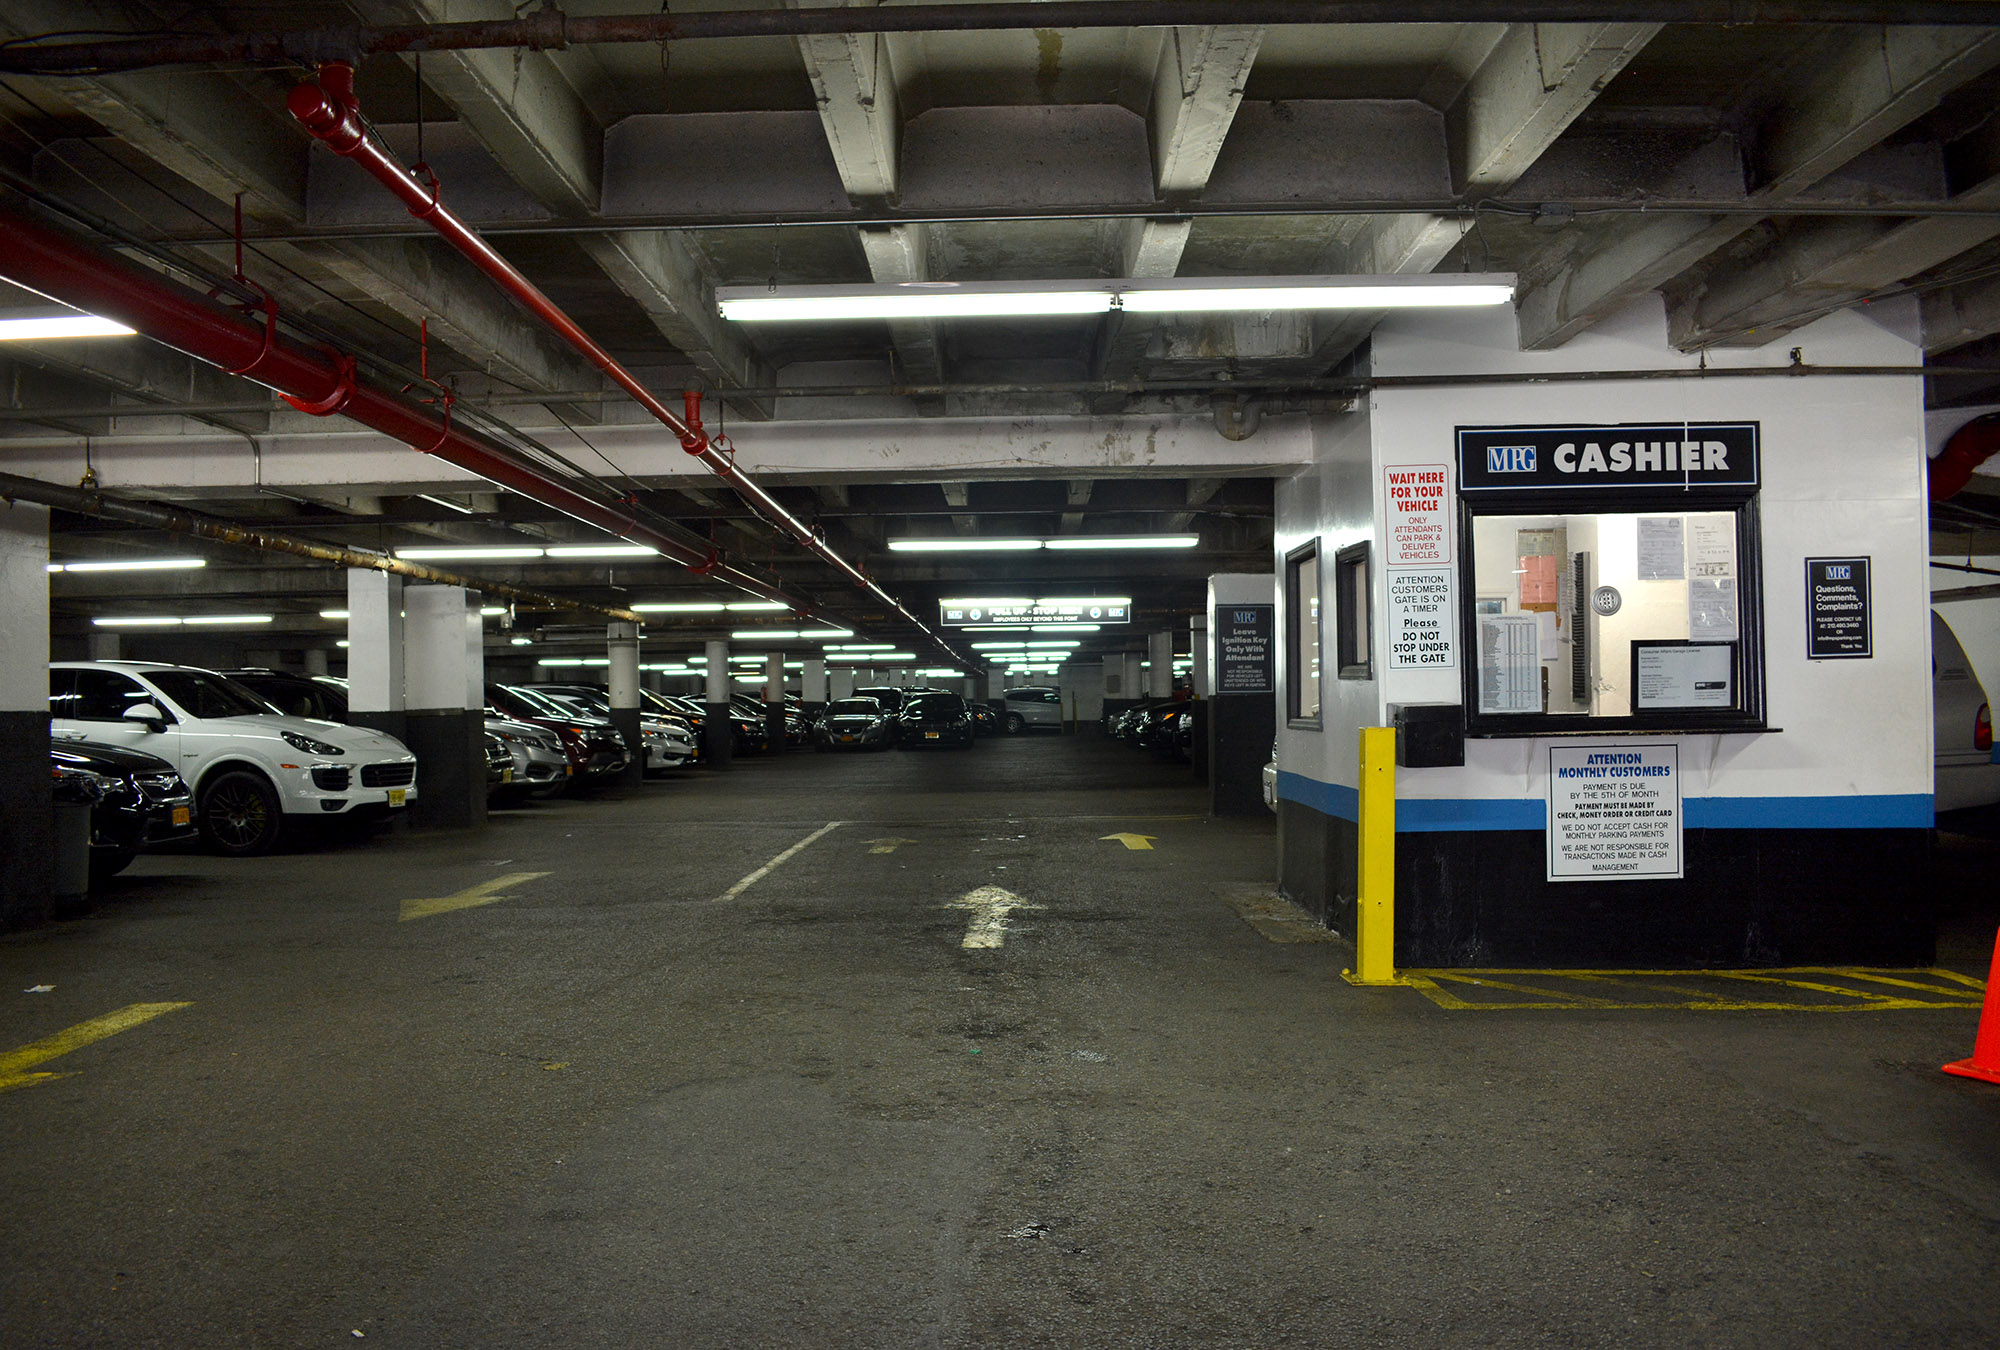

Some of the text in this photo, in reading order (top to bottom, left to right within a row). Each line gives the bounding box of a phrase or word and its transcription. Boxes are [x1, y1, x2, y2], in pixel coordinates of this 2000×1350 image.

[1488, 440, 1730, 473] MPG CASHIER
[1389, 472, 1444, 484] WAIT HERE
[1391, 486, 1443, 498] FOR YOUR
[1397, 500, 1438, 512] VEHICLE
[1394, 525, 1442, 533] ATTENDANTS
[1396, 534, 1412, 542] CAN
[1399, 551, 1439, 559] VEHICLES
[1827, 567, 1850, 579] MPG
[1396, 576, 1443, 584] ATTENTION
[1392, 585, 1448, 594] CUSTOMERS
[1816, 585, 1856, 593] Questions,
[1395, 596, 1417, 604] GATE
[1421, 595, 1429, 603] IS
[1816, 594, 1859, 602] Comments,
[1013, 607, 1026, 615] UP
[1033, 606, 1057, 615] STOP
[1403, 605, 1409, 613] A
[1816, 602, 1863, 611] Complaints?
[1404, 619, 1437, 627] Please
[1222, 637, 1252, 645] Ignition
[1403, 632, 1440, 641] DO NOT
[1394, 643, 1449, 652] STOP UNDER
[1399, 654, 1445, 663] THE GATE
[1587, 753, 1642, 765] ATTENTION
[1559, 766, 1670, 778] MONTHLY CUSTOMERS
[1557, 812, 1578, 820] CHECK,
[1580, 811, 1601, 819] MONEY
[1630, 830, 1664, 838] PAYMENTS
[1564, 852, 1615, 860] TRANSACTIONS
